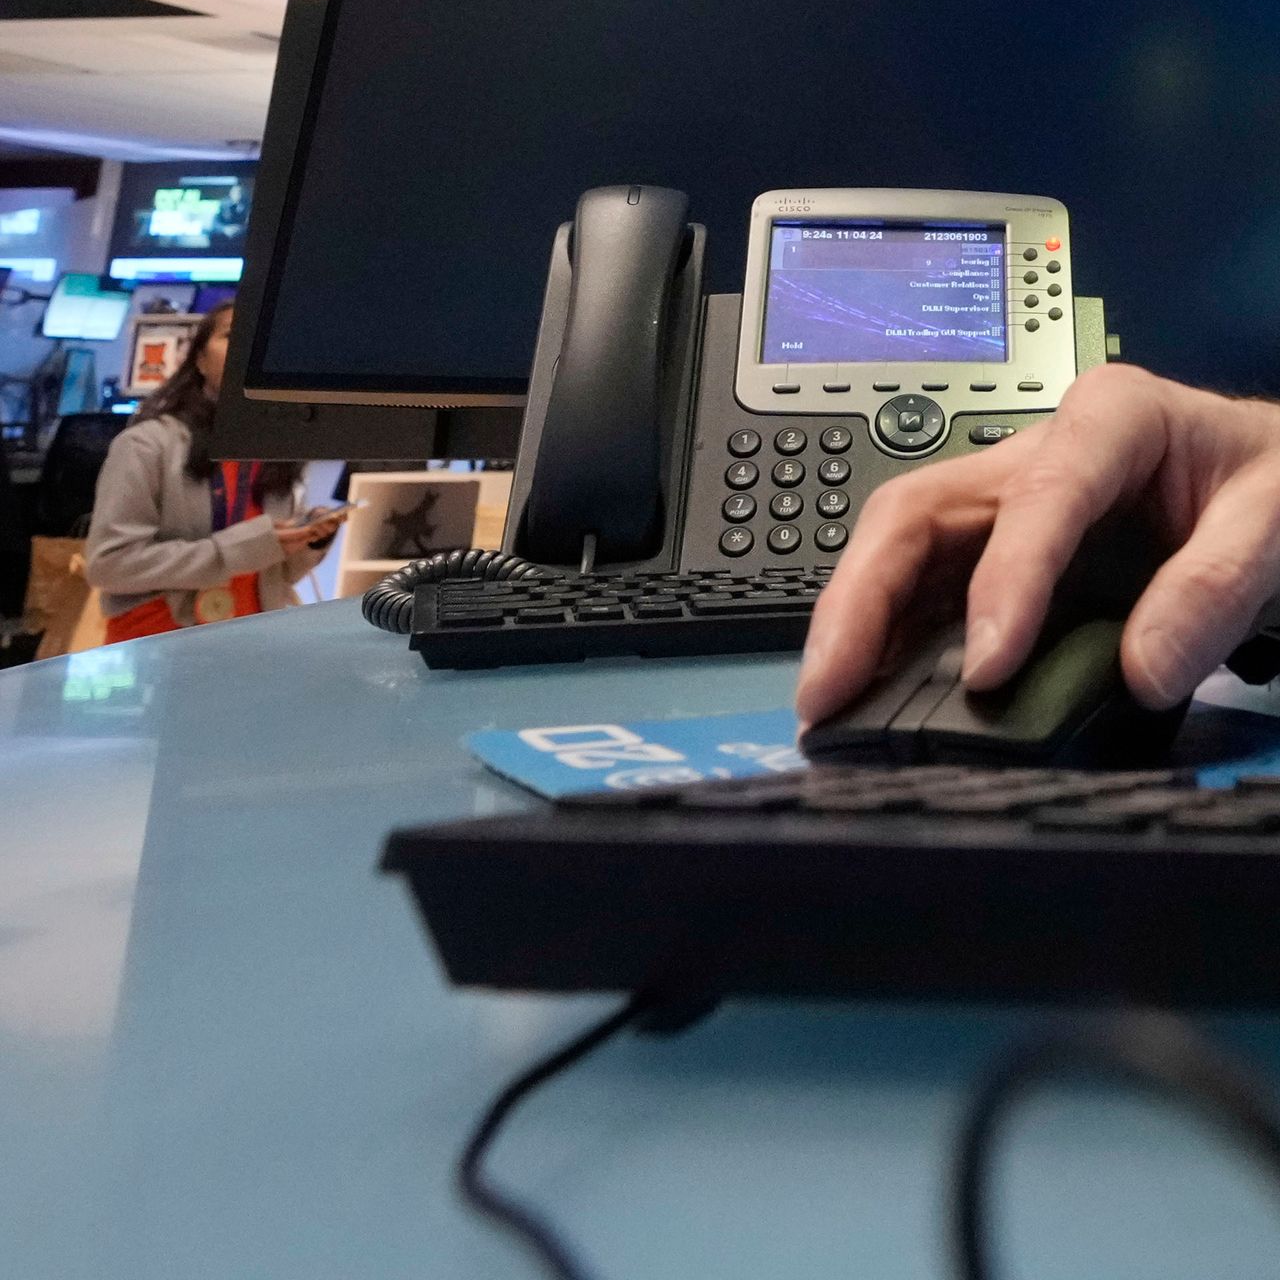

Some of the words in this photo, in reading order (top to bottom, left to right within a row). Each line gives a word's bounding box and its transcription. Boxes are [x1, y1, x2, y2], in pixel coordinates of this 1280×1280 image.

[802, 230, 832, 239] 9:24a
[924, 232, 988, 241] 2123061903
[944, 305, 989, 313] Supervisor
[782, 342, 804, 350] Hold
[787, 432, 796, 442] 2
[832, 431, 840, 442] 3
[738, 466, 746, 476] 4
[784, 464, 793, 474] 5
[830, 462, 838, 472] 6
[736, 498, 744, 509] 7
[783, 496, 791, 506] 8
[830, 494, 838, 504] 9
[780, 530, 788, 540] 0
